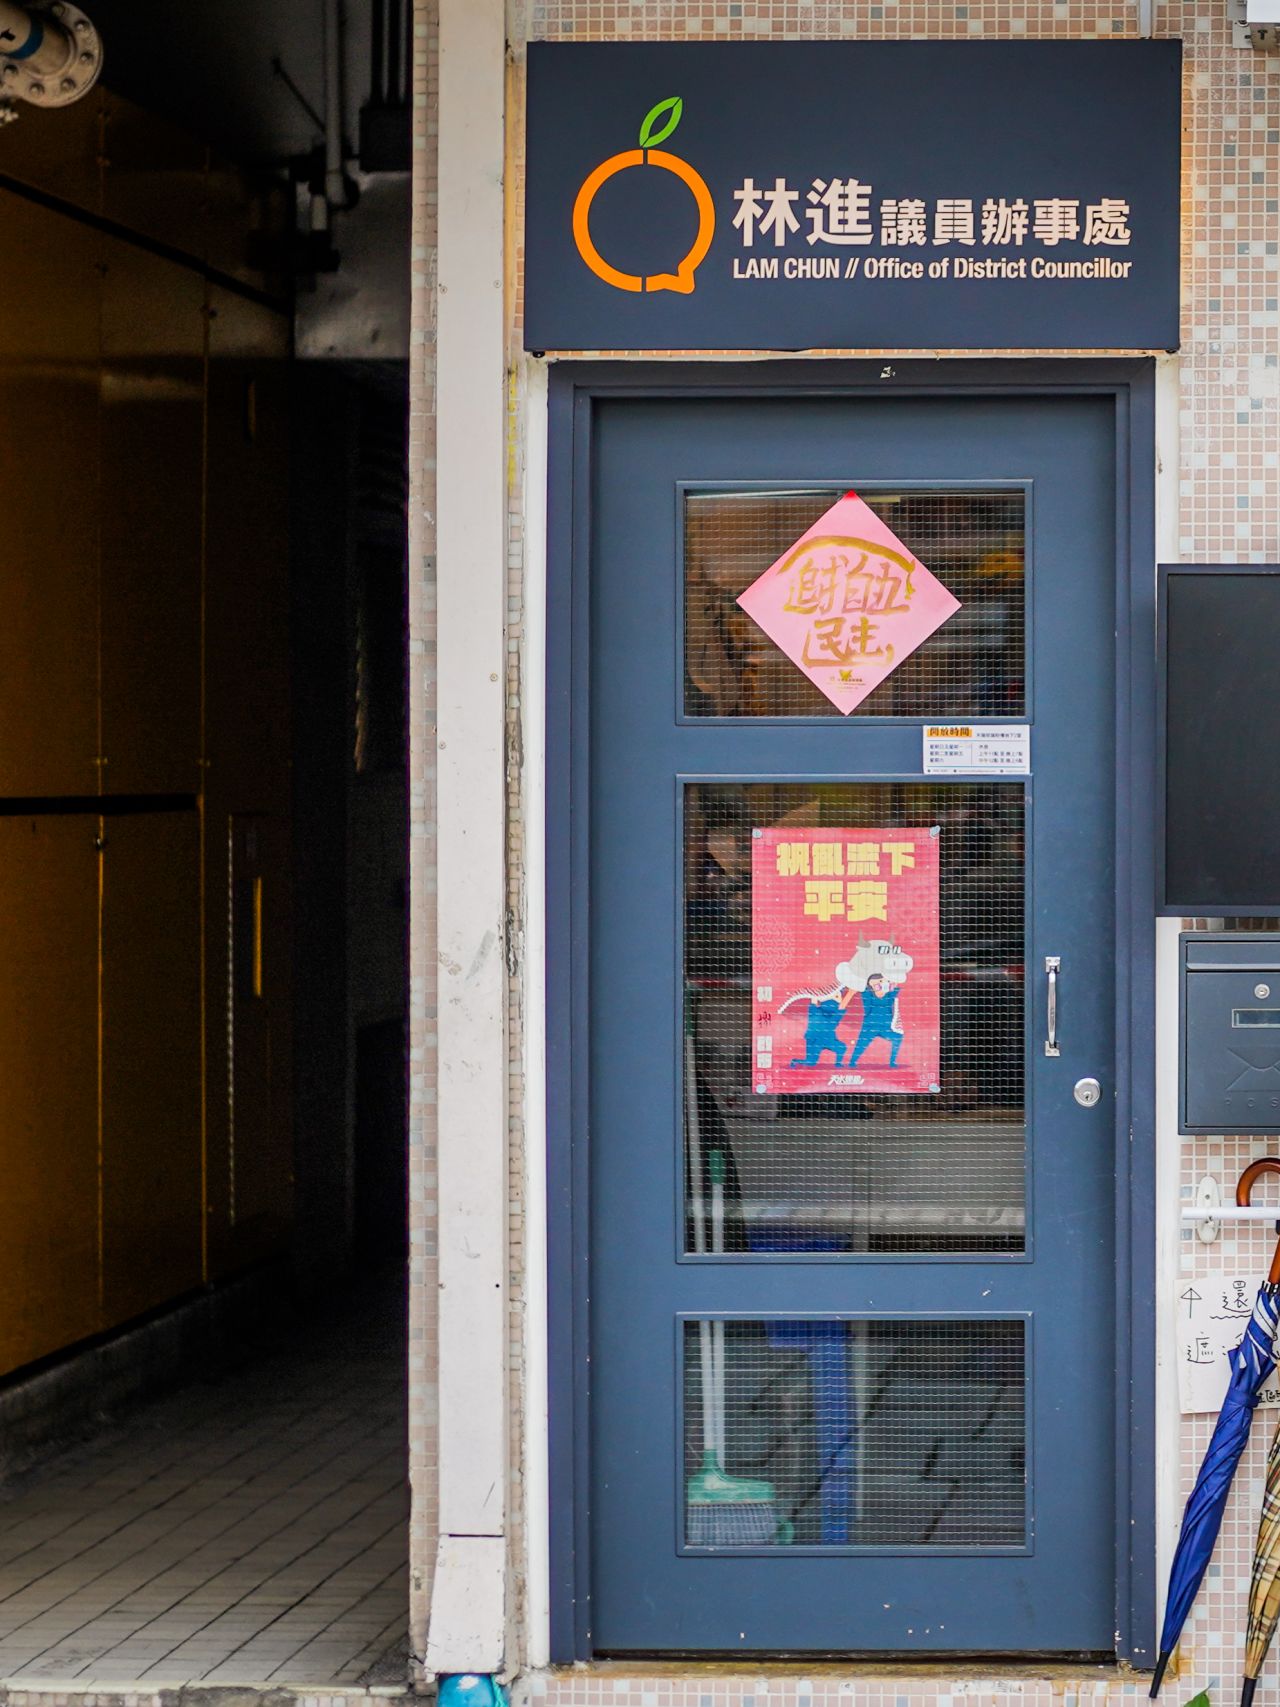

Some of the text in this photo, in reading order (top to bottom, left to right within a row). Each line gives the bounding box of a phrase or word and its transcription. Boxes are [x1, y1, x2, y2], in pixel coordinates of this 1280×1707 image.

[732, 178, 1132, 246] 林進議員辦事處
[733, 258, 778, 279] LAM
[784, 258, 839, 279] CHUN
[864, 258, 924, 279] Office
[929, 258, 949, 279] of
[954, 258, 1027, 279] District
[1031, 258, 1132, 279] Councillor
[803, 880, 888, 922] 平安
